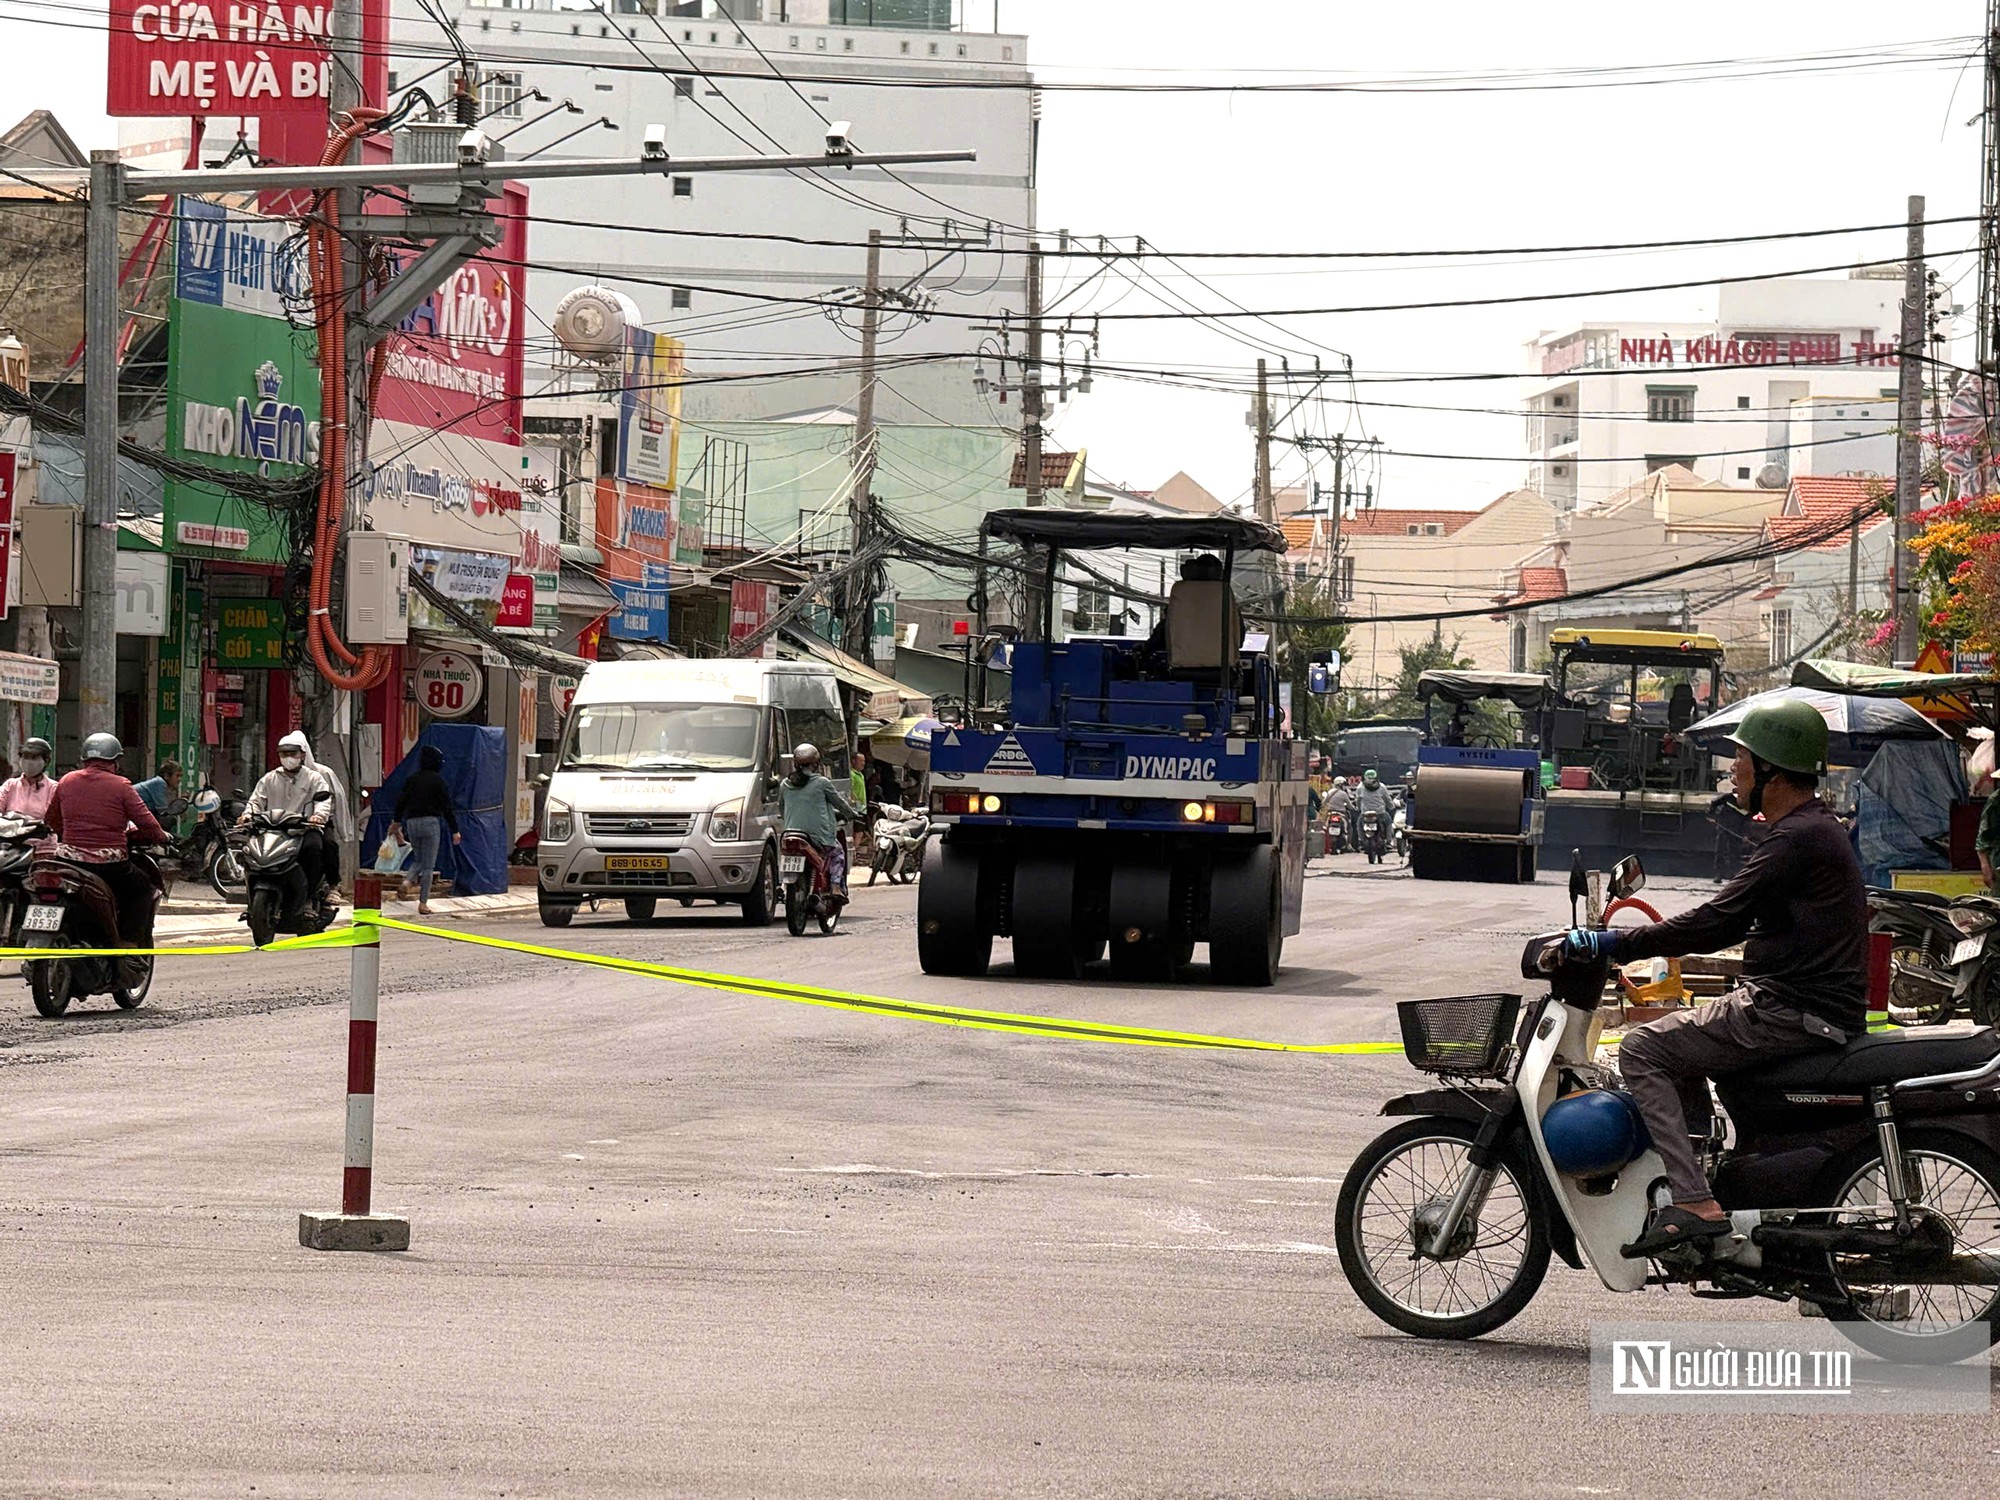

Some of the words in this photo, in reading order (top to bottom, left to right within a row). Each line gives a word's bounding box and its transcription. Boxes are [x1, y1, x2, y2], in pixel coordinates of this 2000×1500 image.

[229, 0, 334, 42] HÀN
[150, 60, 217, 108] MẸ
[225, 50, 281, 98] VÀ
[1620, 332, 1674, 363] NHÀ
[184, 401, 234, 457] KHO
[509, 602, 522, 616] BÉ
[423, 668, 441, 680] NHÀ
[444, 668, 471, 682] THUỐC
[427, 681, 464, 709] 80
[998, 750, 1024, 760] RDG
[1125, 756, 1216, 780] DYNAPAC
[1459, 751, 1497, 760] HYSTER
